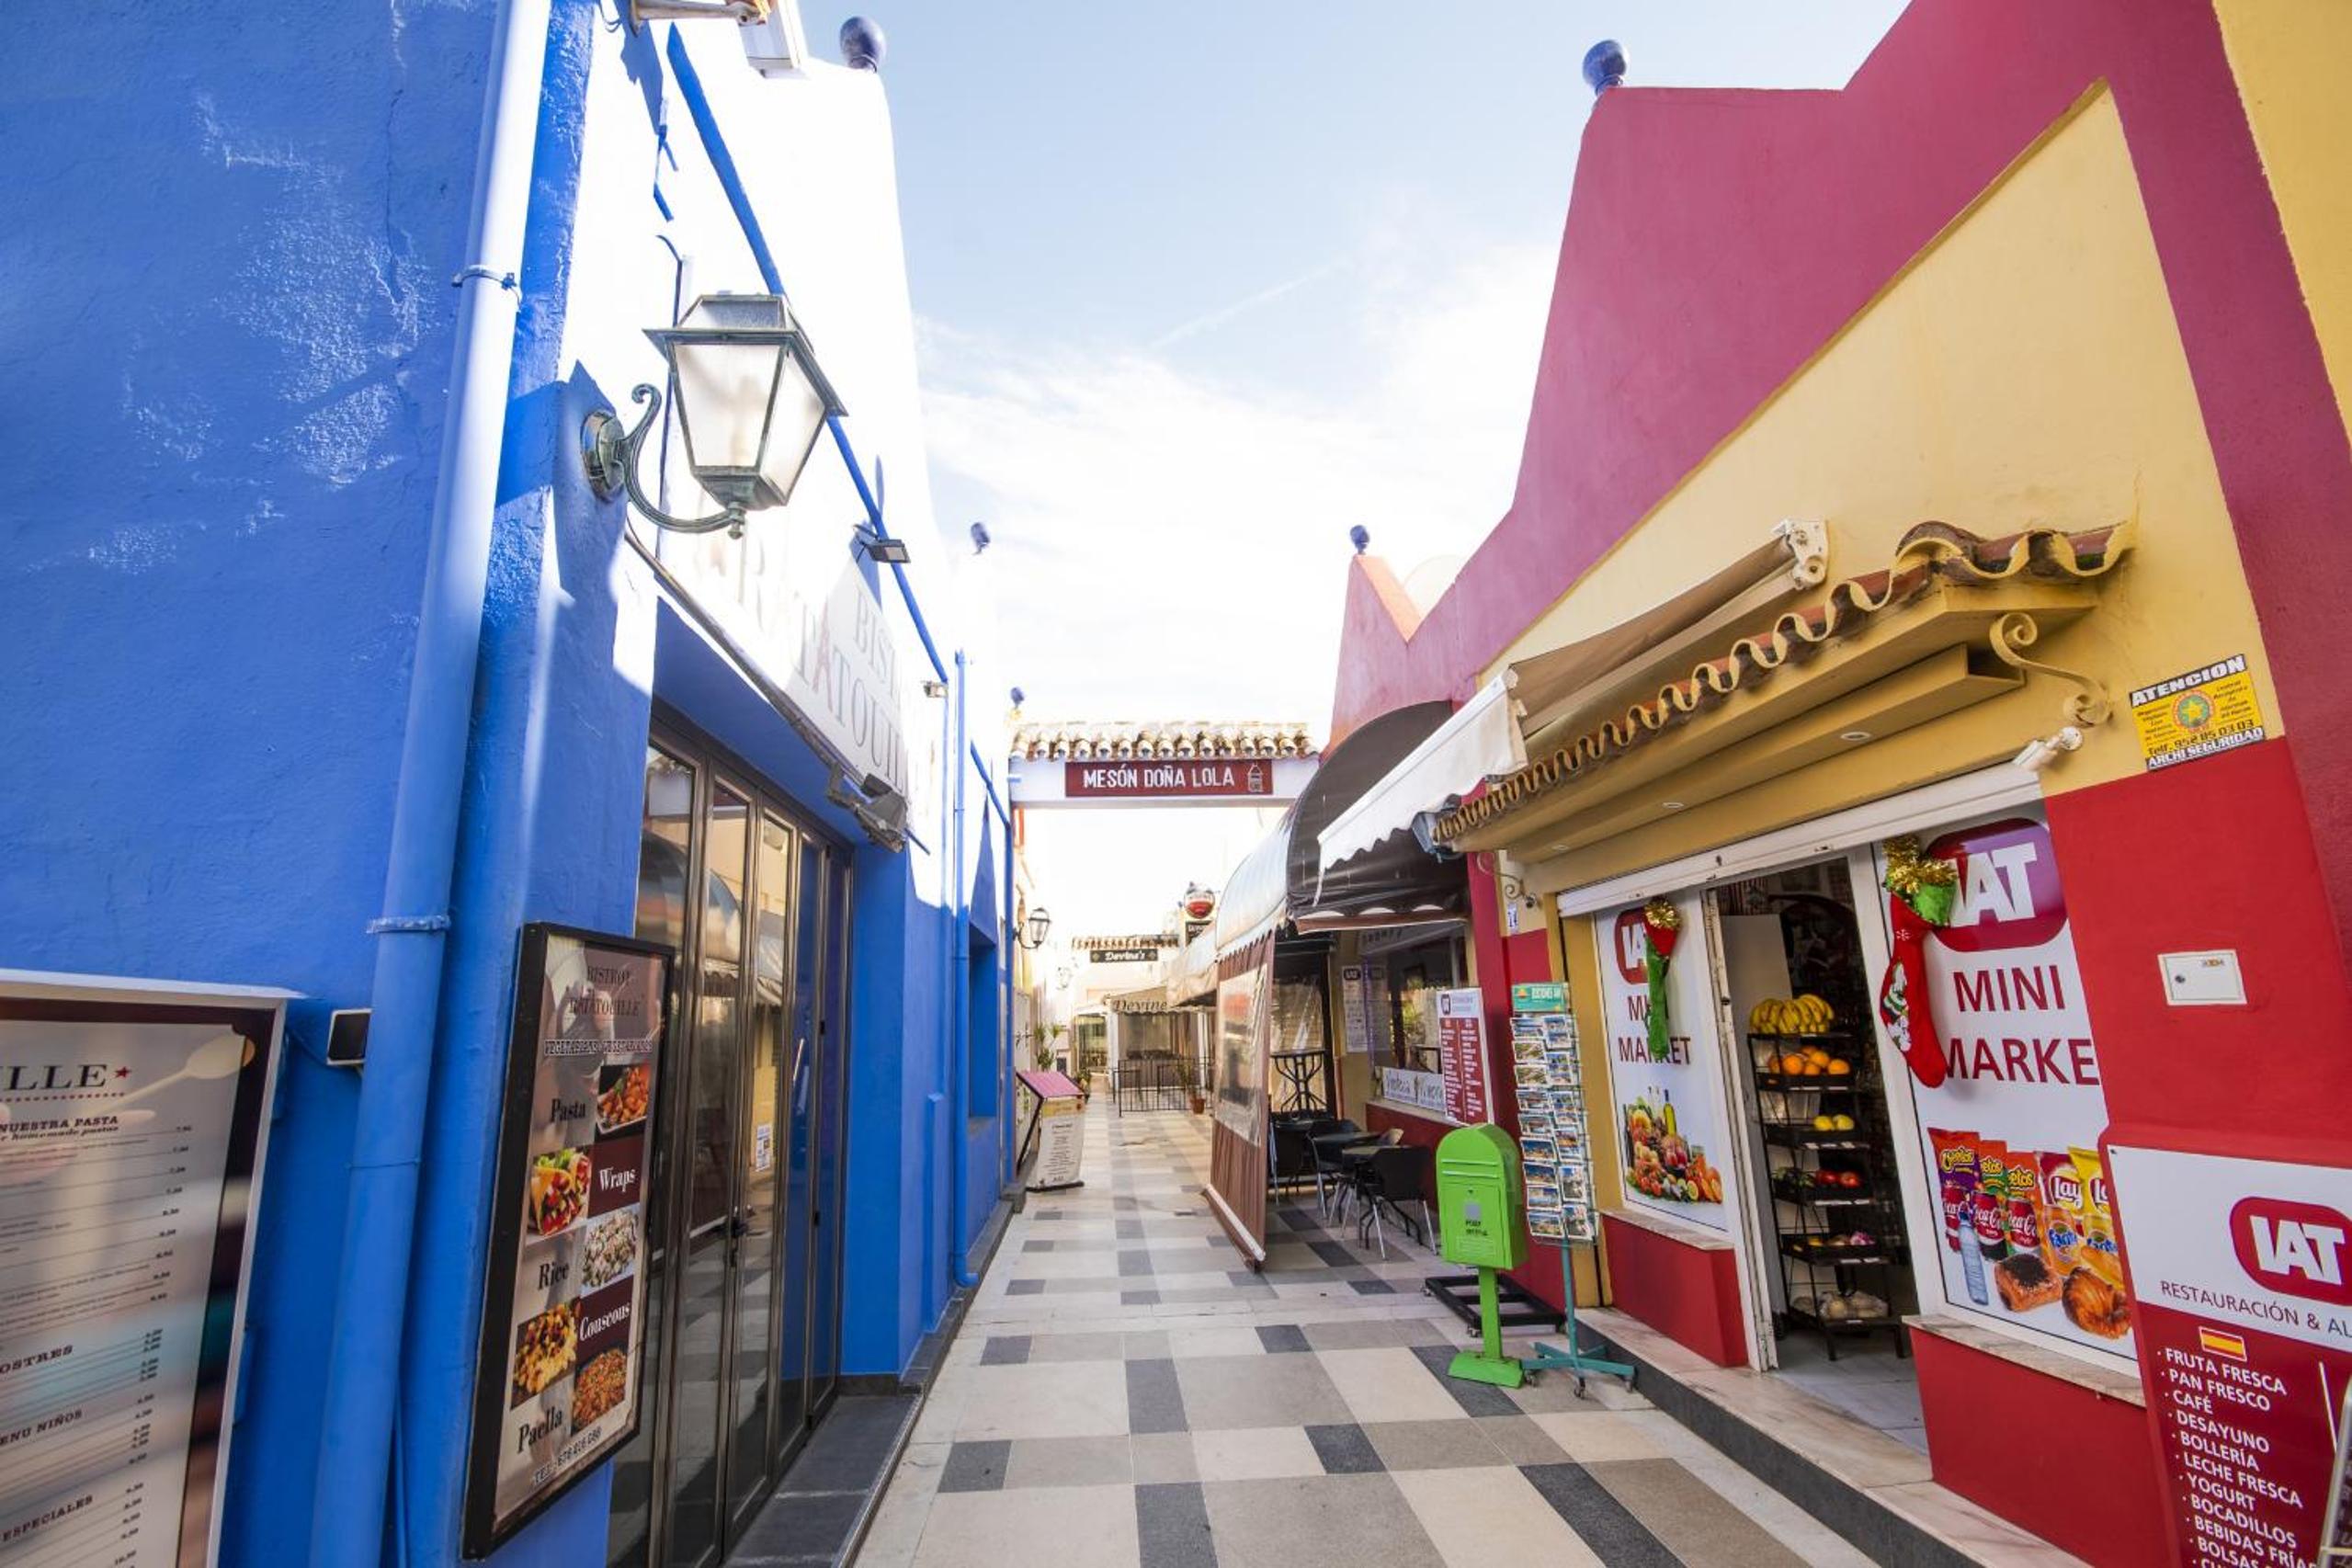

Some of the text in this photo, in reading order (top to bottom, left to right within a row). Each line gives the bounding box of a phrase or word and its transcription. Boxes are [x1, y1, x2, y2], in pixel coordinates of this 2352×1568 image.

[2131, 654, 2245, 707] ATENCION
[1083, 763, 1234, 789] MESÓN DOÑA LOLA
[1953, 965, 2065, 1012] MINI
[1619, 1037, 1691, 1065] MAET
[1946, 1039, 2100, 1085] MARKE
[2, 1064, 108, 1091] LLE
[74, 1115, 118, 1127] PASTA
[550, 1098, 585, 1122] Pasta
[599, 1166, 636, 1192] Wraps
[2055, 1176, 2084, 1210] Lay
[538, 1260, 570, 1291] Rice
[580, 1301, 631, 1341] Couscous
[2161, 1280, 2300, 1326] RESTAURACIÓN
[2307, 1312, 2320, 1330] &
[0, 1345, 74, 1374] OSTRES
[2165, 1348, 2288, 1395] FRUTA FRESCA
[2169, 1369, 2271, 1412] PAN FRESCO
[2173, 1390, 2213, 1415] CAFÉ
[0, 1409, 83, 1446] ENU NIÑOS
[517, 1406, 563, 1454] Paella
[2176, 1410, 2270, 1452] DESAYUNO
[2180, 1431, 2260, 1471] BOLLERÍA
[2184, 1451, 2303, 1508] LECHE FRESCA
[2187, 1472, 2255, 1511] YOGURT
[3, 1494, 93, 1541] ESPECIALES
[2191, 1494, 2297, 1549] BOCADILLOS
[2195, 1515, 2265, 1556] BEBIDAS
